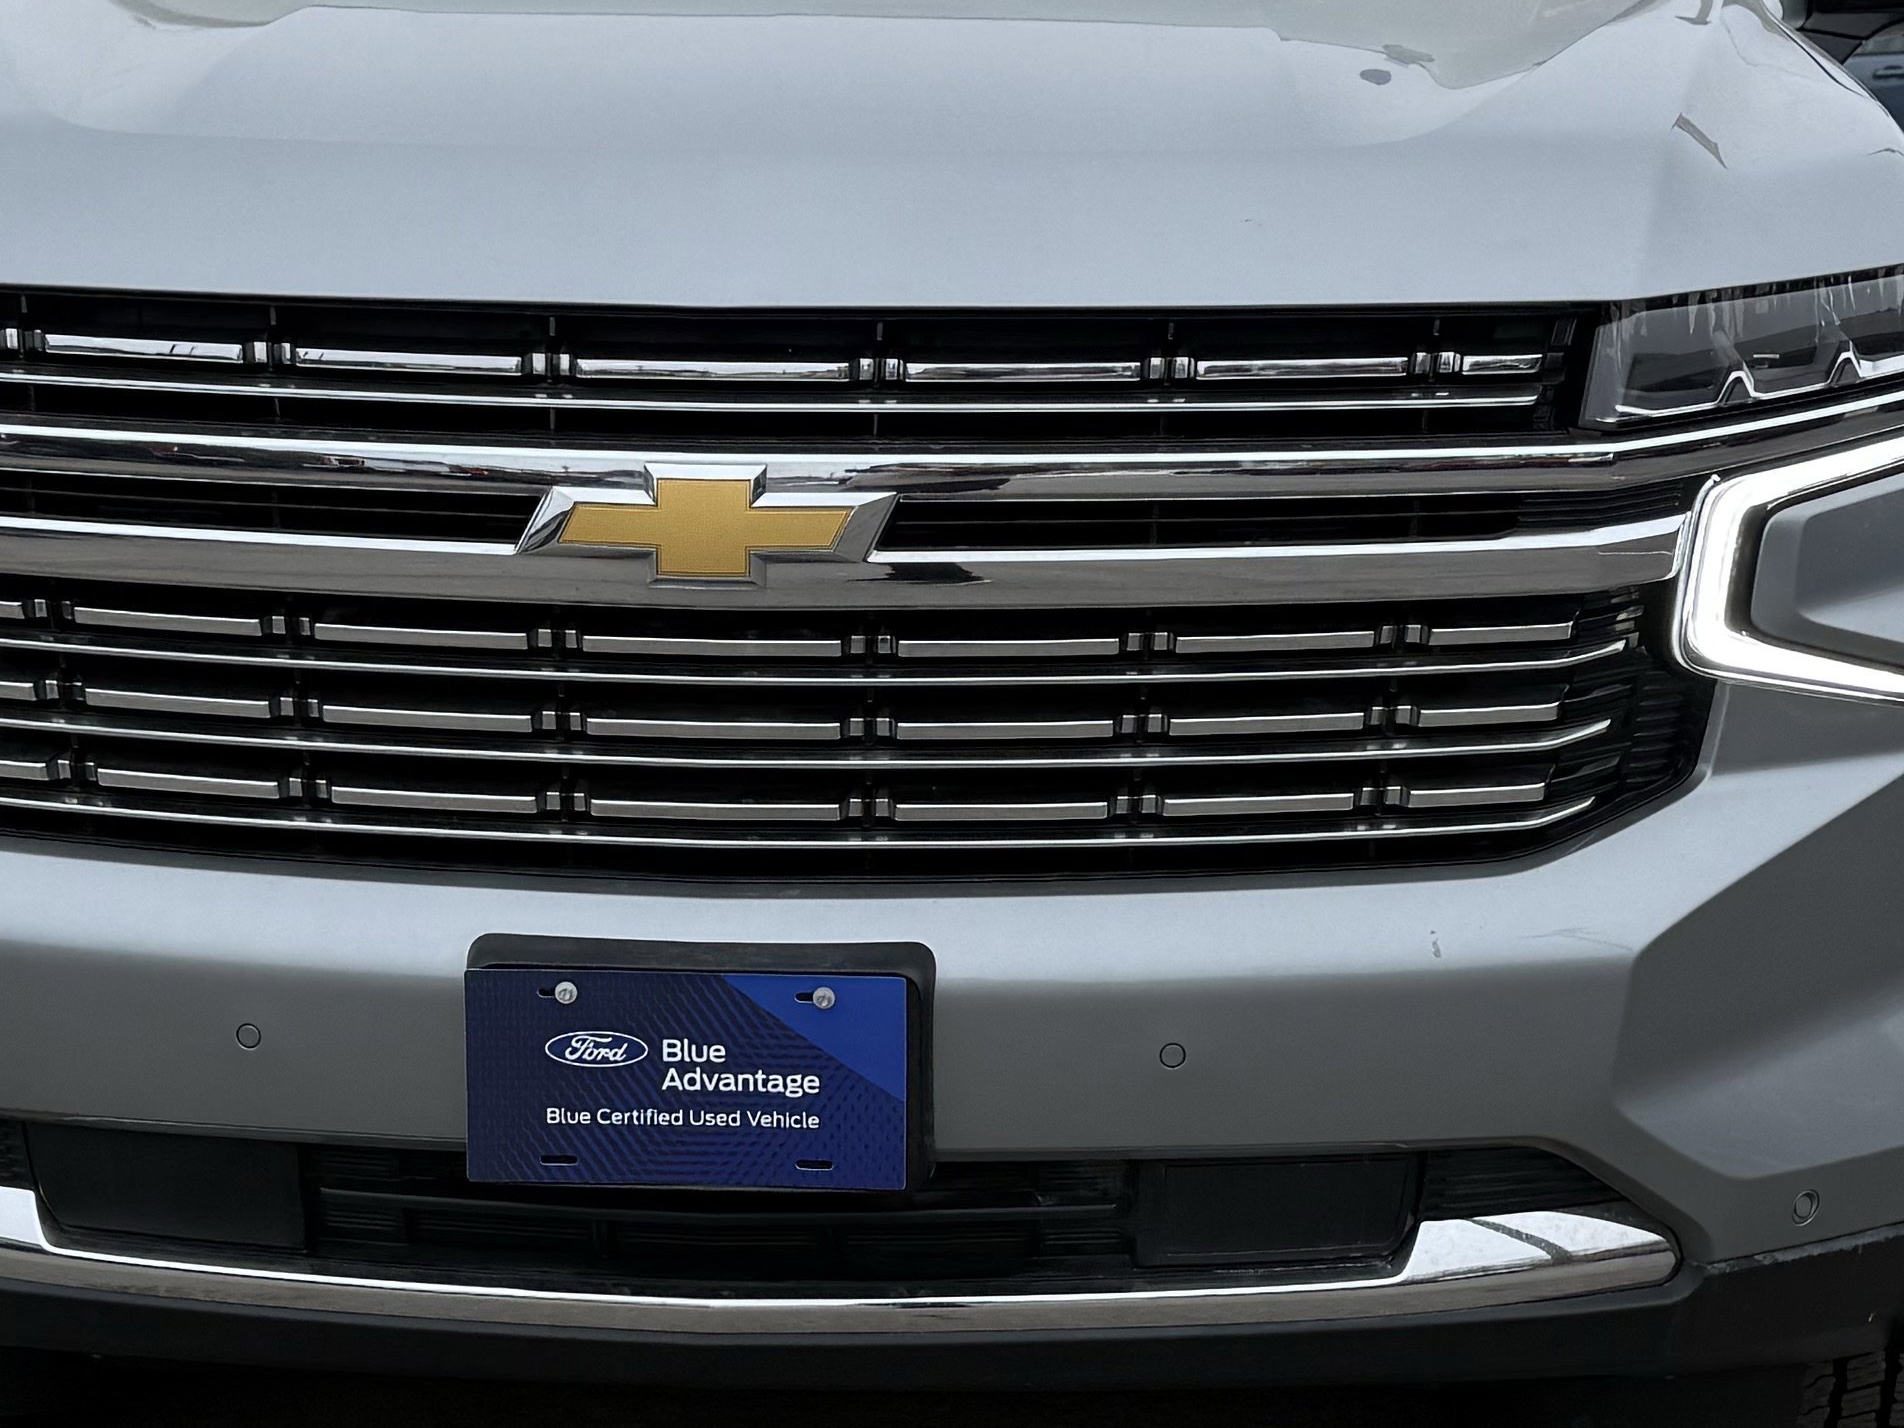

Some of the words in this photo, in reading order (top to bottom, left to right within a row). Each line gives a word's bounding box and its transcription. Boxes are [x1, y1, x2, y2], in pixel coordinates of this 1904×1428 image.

[564, 1035, 628, 1061] Ford
[661, 1038, 727, 1063] Blue
[661, 1067, 821, 1098] Advantage
[546, 1107, 591, 1125] Blue
[596, 1108, 683, 1126] Certified
[689, 1110, 741, 1127] Used
[747, 1110, 821, 1129] Vehicle
